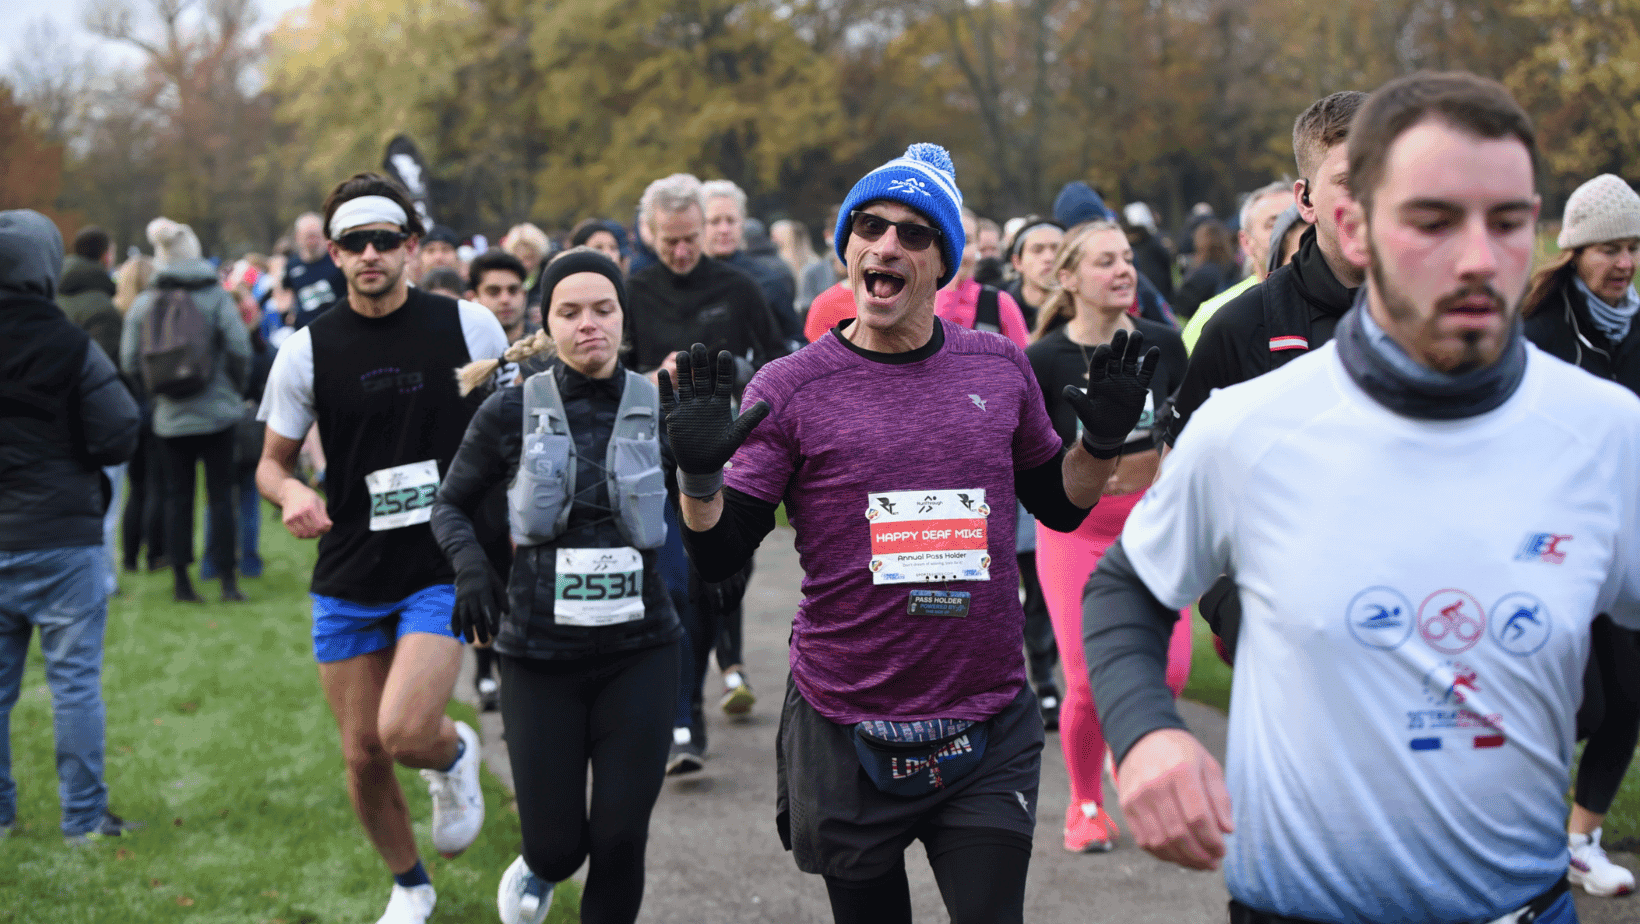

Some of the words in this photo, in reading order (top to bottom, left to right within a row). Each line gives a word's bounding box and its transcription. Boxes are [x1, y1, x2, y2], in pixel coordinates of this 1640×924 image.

[373, 483, 437, 517] 2523
[875, 530, 919, 543] HAPPY
[921, 529, 952, 540] DEAF
[954, 528, 983, 539] MIKE
[897, 553, 924, 562] Annual
[944, 552, 967, 560] Holder
[562, 572, 639, 600] 2531
[933, 597, 963, 605] HOLDER
